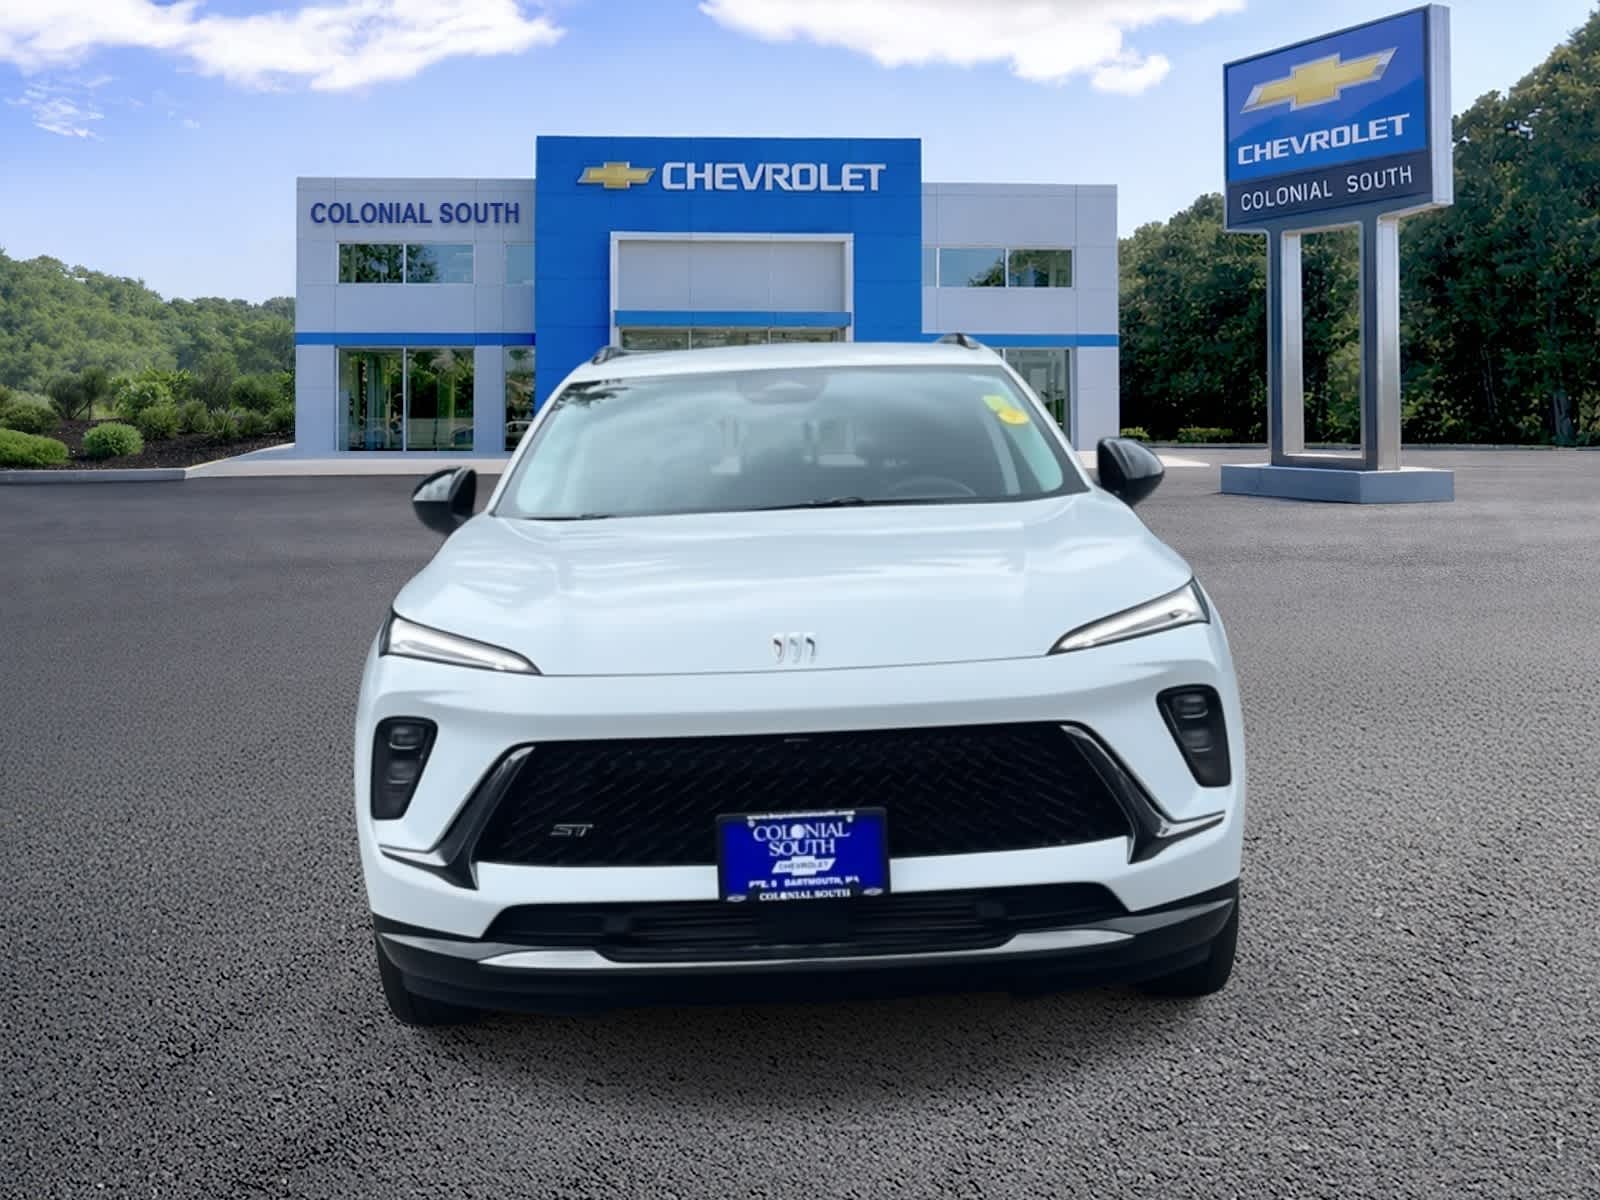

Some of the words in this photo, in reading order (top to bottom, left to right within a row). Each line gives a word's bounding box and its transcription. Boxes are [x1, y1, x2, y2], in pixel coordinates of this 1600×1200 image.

[1237, 113, 1410, 165] CHEVROLET
[662, 162, 887, 191] CHEVROLET
[1240, 180, 1333, 211] COLONIAL
[1346, 165, 1413, 193] SOUTH
[310, 202, 433, 224] COLONIAL
[439, 202, 520, 224] SOUTH
[550, 823, 594, 837] ST
[753, 822, 851, 842] COLONIAL
[768, 838, 835, 856] SOUTH
[759, 891, 811, 901] COLONIAL
[814, 888, 851, 898] SOUTH
